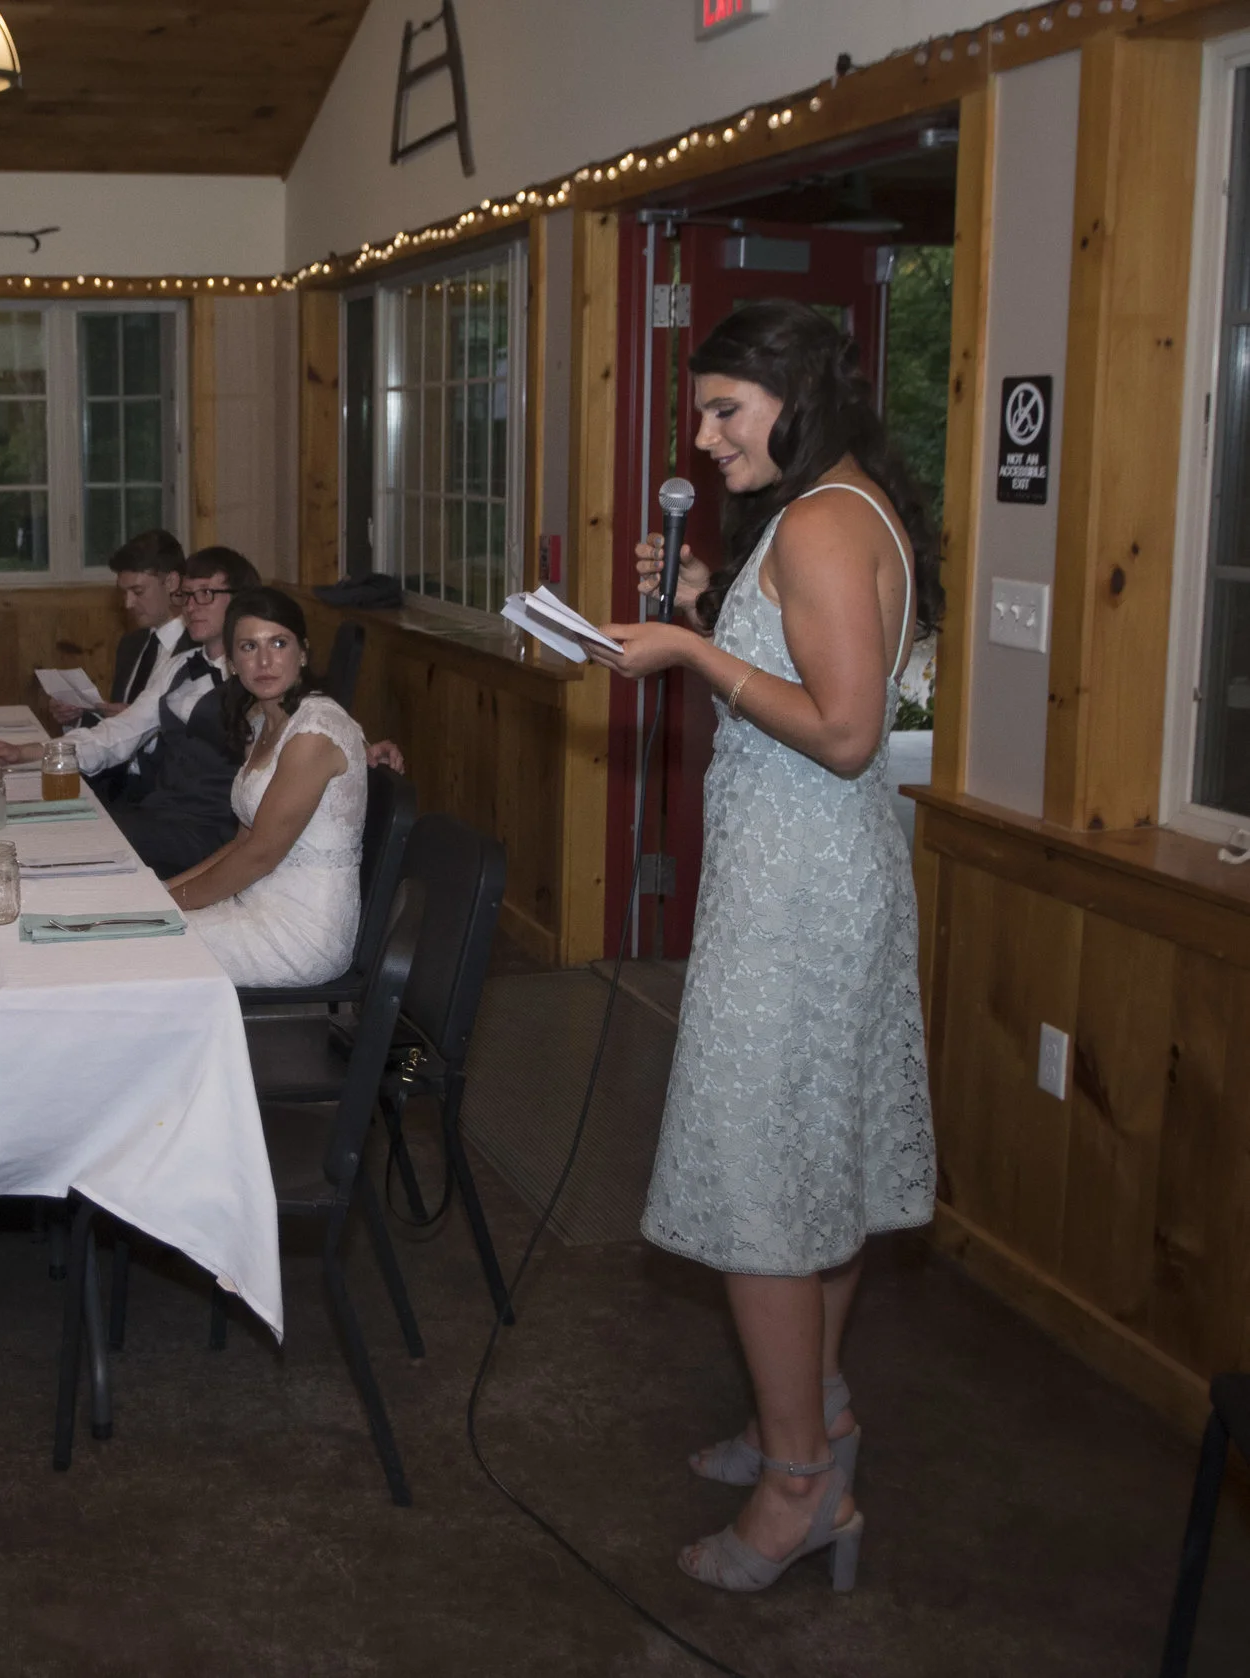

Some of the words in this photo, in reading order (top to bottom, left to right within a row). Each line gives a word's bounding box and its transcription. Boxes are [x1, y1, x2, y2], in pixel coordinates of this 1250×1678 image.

[1006, 453, 1023, 465] NOT
[1026, 453, 1039, 465] AN
[1012, 478, 1030, 490] EXIT
